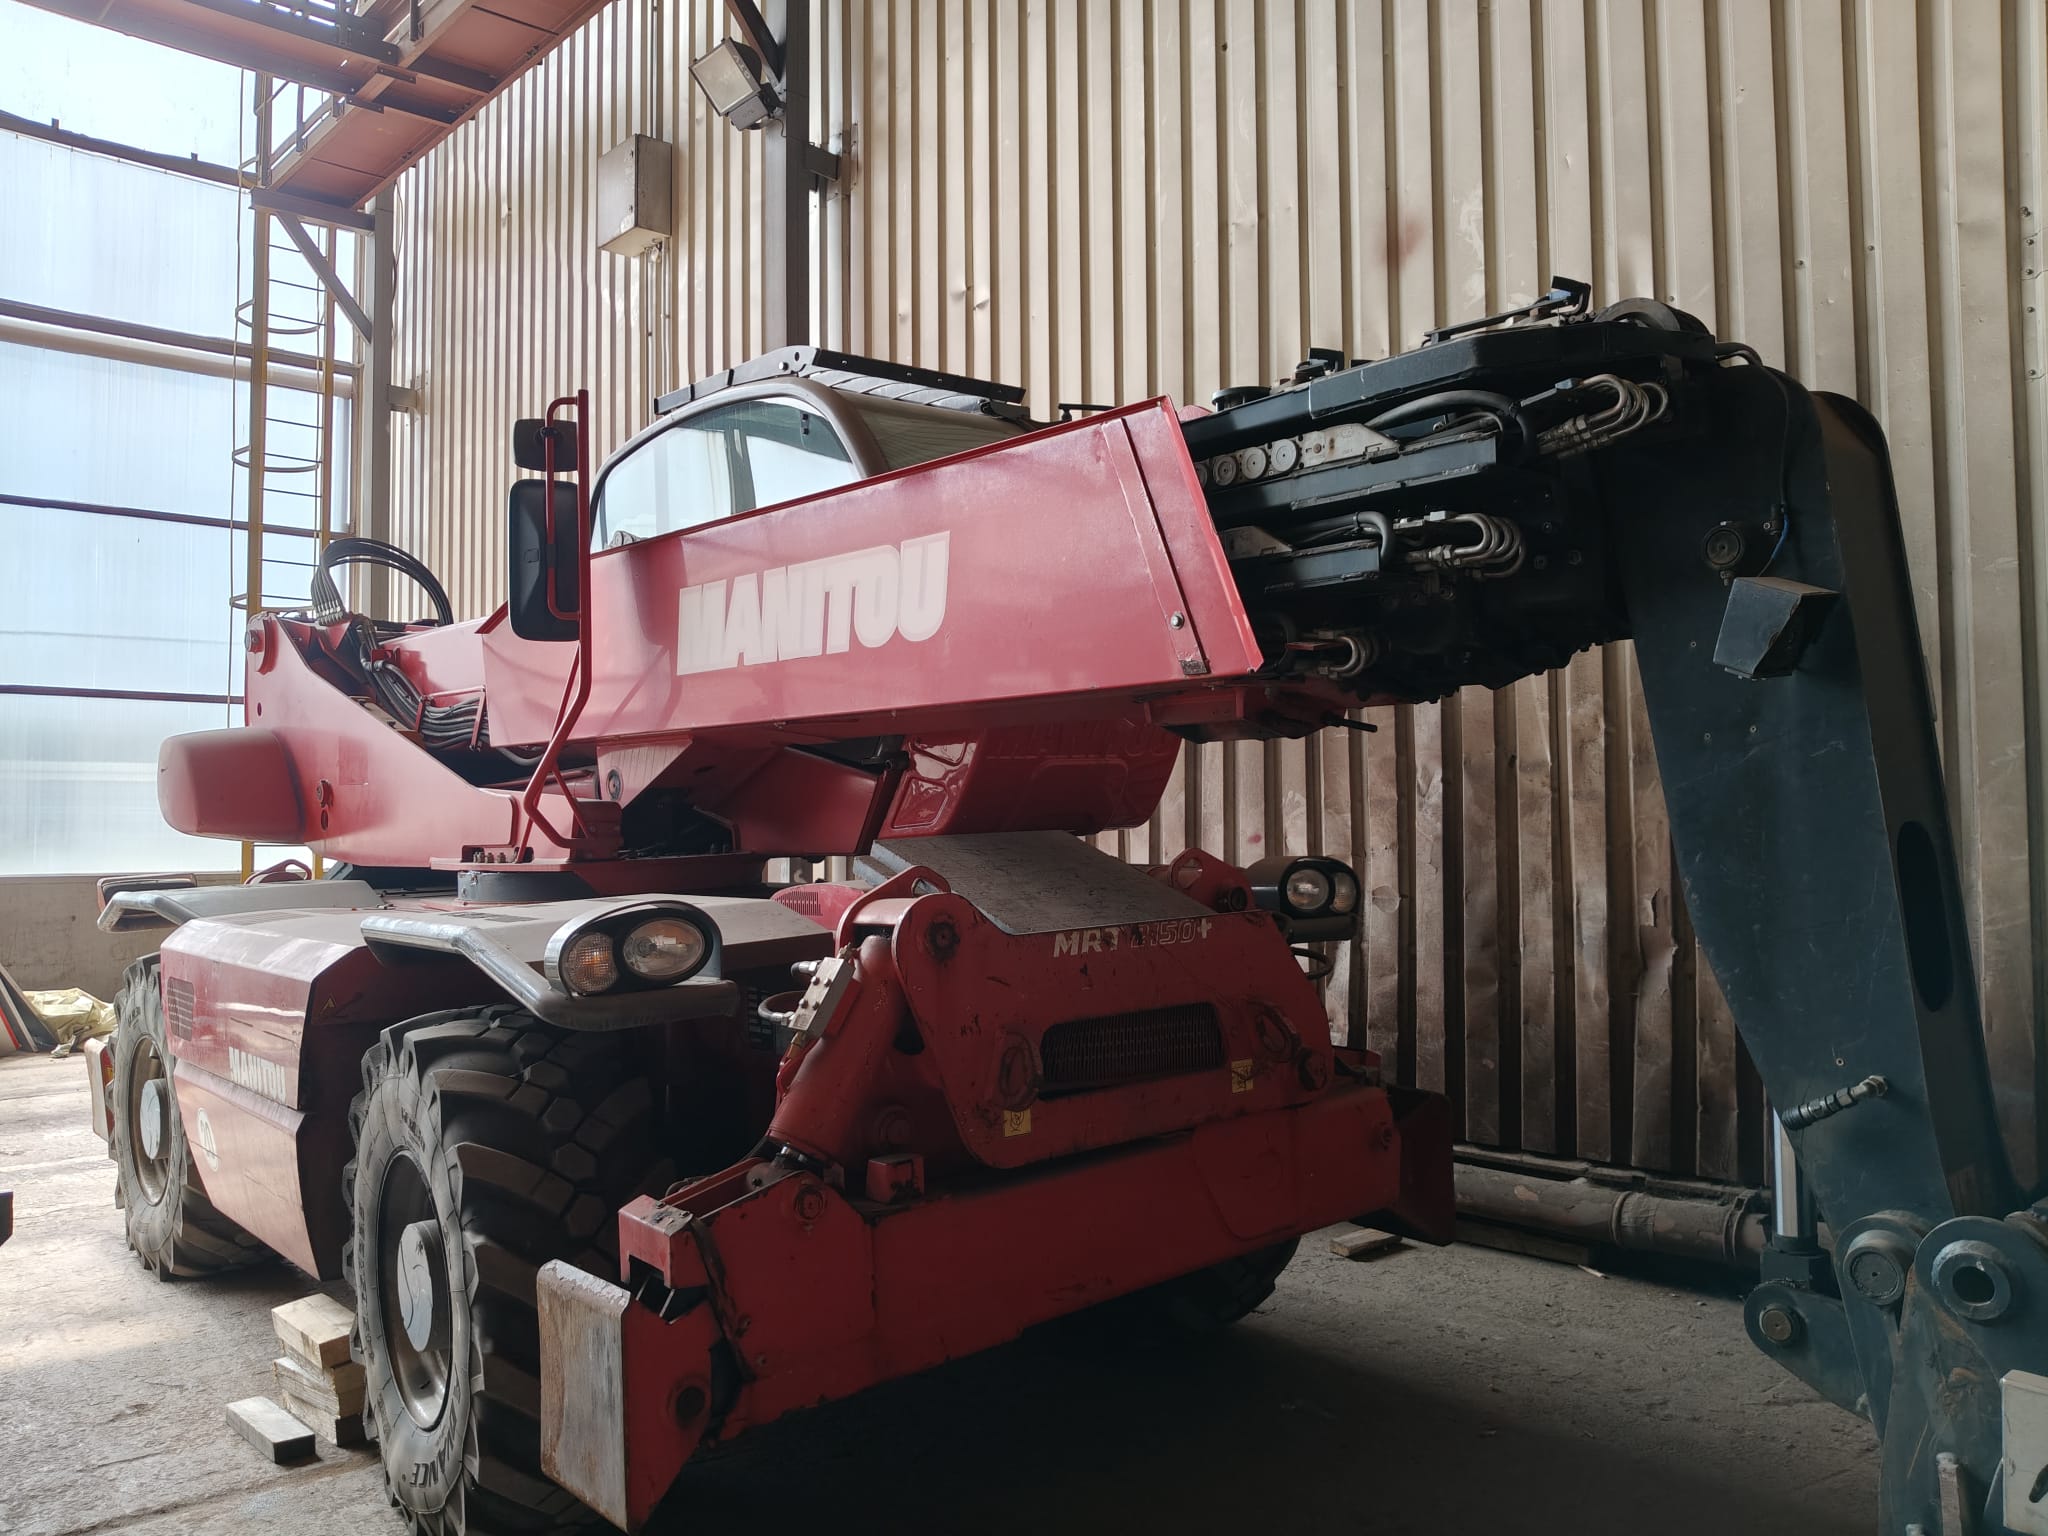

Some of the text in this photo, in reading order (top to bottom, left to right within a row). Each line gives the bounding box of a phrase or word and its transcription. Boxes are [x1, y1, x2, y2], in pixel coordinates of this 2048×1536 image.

[677, 530, 951, 676] MANITOU
[1053, 927, 1122, 957] MRT
[229, 1046, 285, 1104] MANITOU
